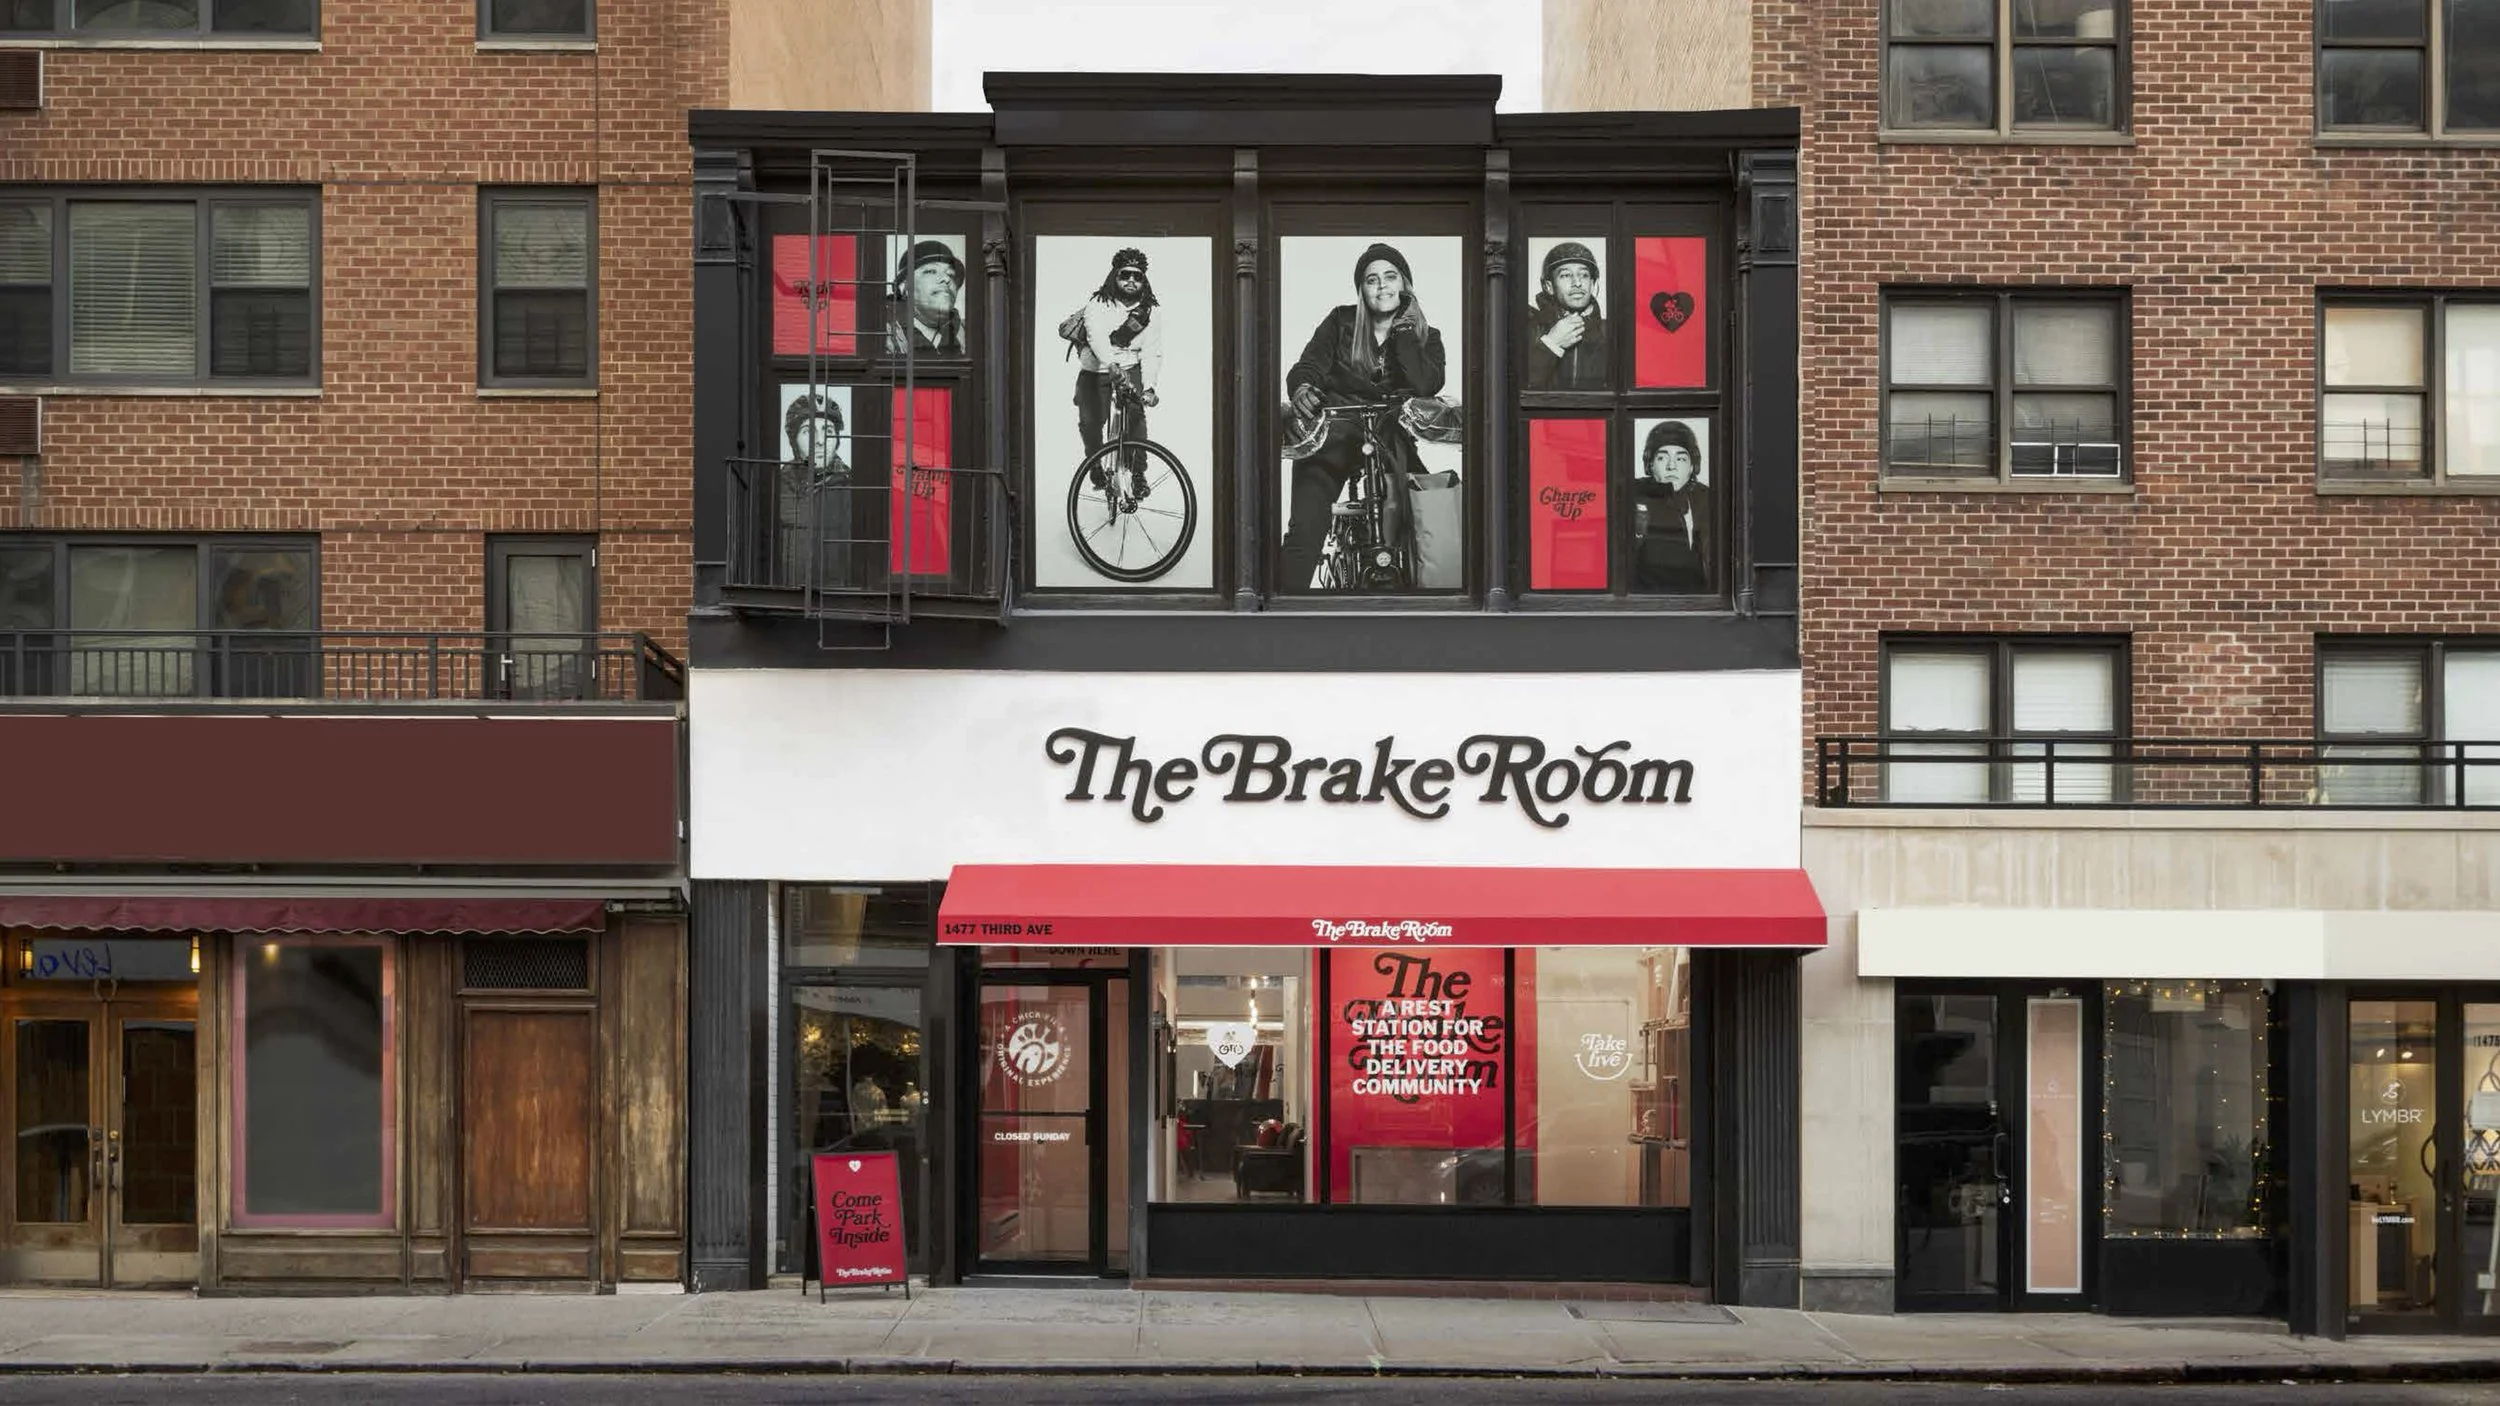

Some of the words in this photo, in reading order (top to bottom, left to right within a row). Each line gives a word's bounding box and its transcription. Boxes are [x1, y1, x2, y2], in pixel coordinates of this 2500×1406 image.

[1539, 486, 1596, 505] Charge
[1553, 503, 1582, 521] Up
[1045, 727, 1198, 823] The
[1201, 734, 1455, 819] Brake
[1457, 734, 1695, 828] Room
[945, 924, 976, 935] 1477
[981, 924, 1021, 935] THIRD
[1026, 924, 1053, 935] AVE
[1312, 919, 1346, 941] The
[1346, 920, 1400, 941] Brake
[1401, 920, 1452, 942] Room
[1374, 952, 1471, 1002] The
[1382, 1000, 1396, 1015] A
[1402, 1000, 1454, 1015] REST
[1352, 1020, 1437, 1035] STATION
[1443, 1020, 1483, 1035] FOR
[1367, 1040, 1407, 1055] THE
[1412, 1040, 1468, 1055] FOOD
[1580, 1033, 1626, 1051] Take
[1367, 1059, 1469, 1075] DELIVERY
[1352, 1079, 1483, 1095] COMMUNITY
[994, 1132, 1031, 1141] CLOSED
[1033, 1132, 1071, 1141] SUNDAY
[831, 1190, 882, 1209] Come
[834, 1208, 891, 1229] Park
[829, 1227, 890, 1249] Inside
